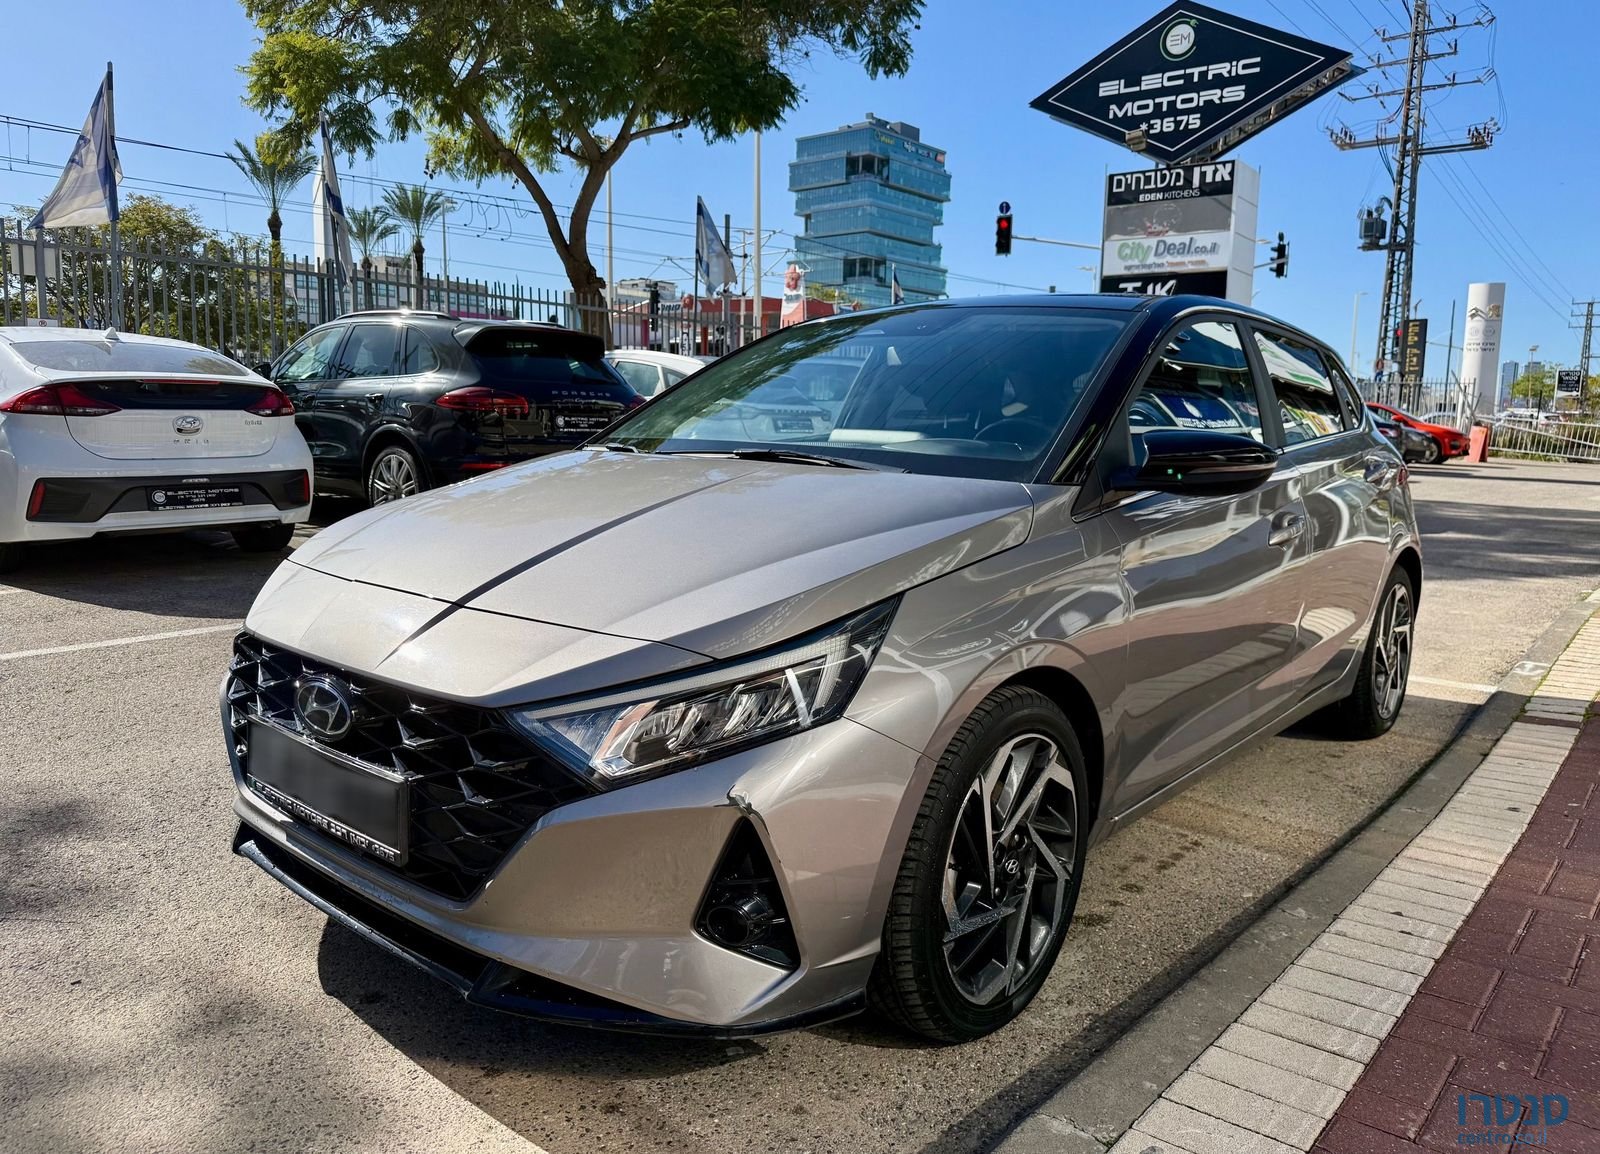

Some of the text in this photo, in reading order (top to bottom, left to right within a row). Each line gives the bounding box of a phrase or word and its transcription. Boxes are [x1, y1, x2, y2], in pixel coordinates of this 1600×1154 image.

[1108, 85, 1246, 119] MOTORS
[1113, 163, 1232, 193] אדן מטבחים
[1139, 189, 1200, 202] EDEN KITCHENS
[1117, 241, 1151, 263] City
